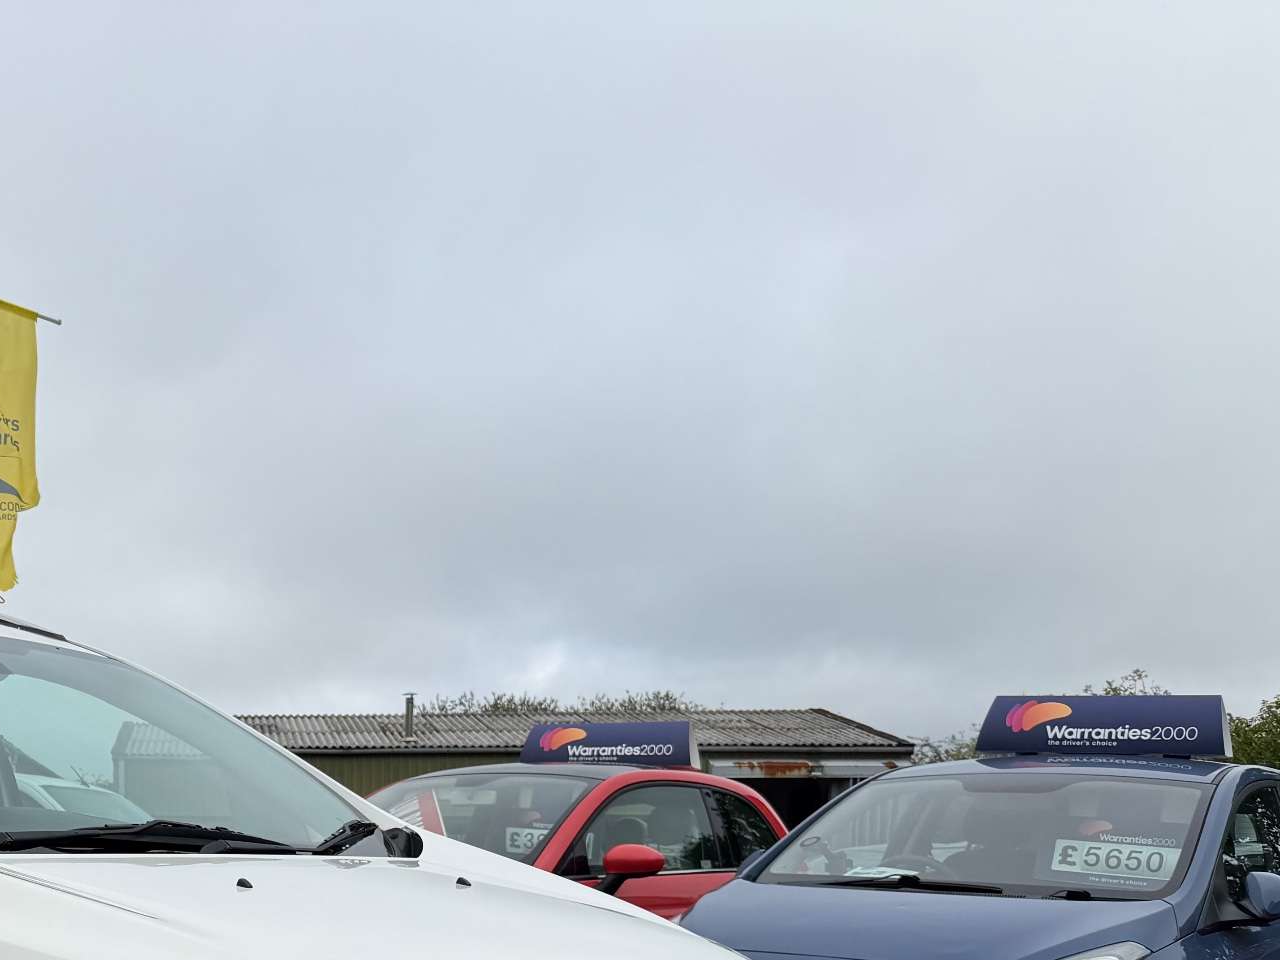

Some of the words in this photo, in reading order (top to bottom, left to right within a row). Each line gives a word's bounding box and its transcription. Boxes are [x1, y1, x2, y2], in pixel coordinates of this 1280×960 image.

[1046, 725, 1198, 741] Warranties2000
[567, 744, 673, 756] Warranties2000
[1058, 844, 1164, 873] £5650
